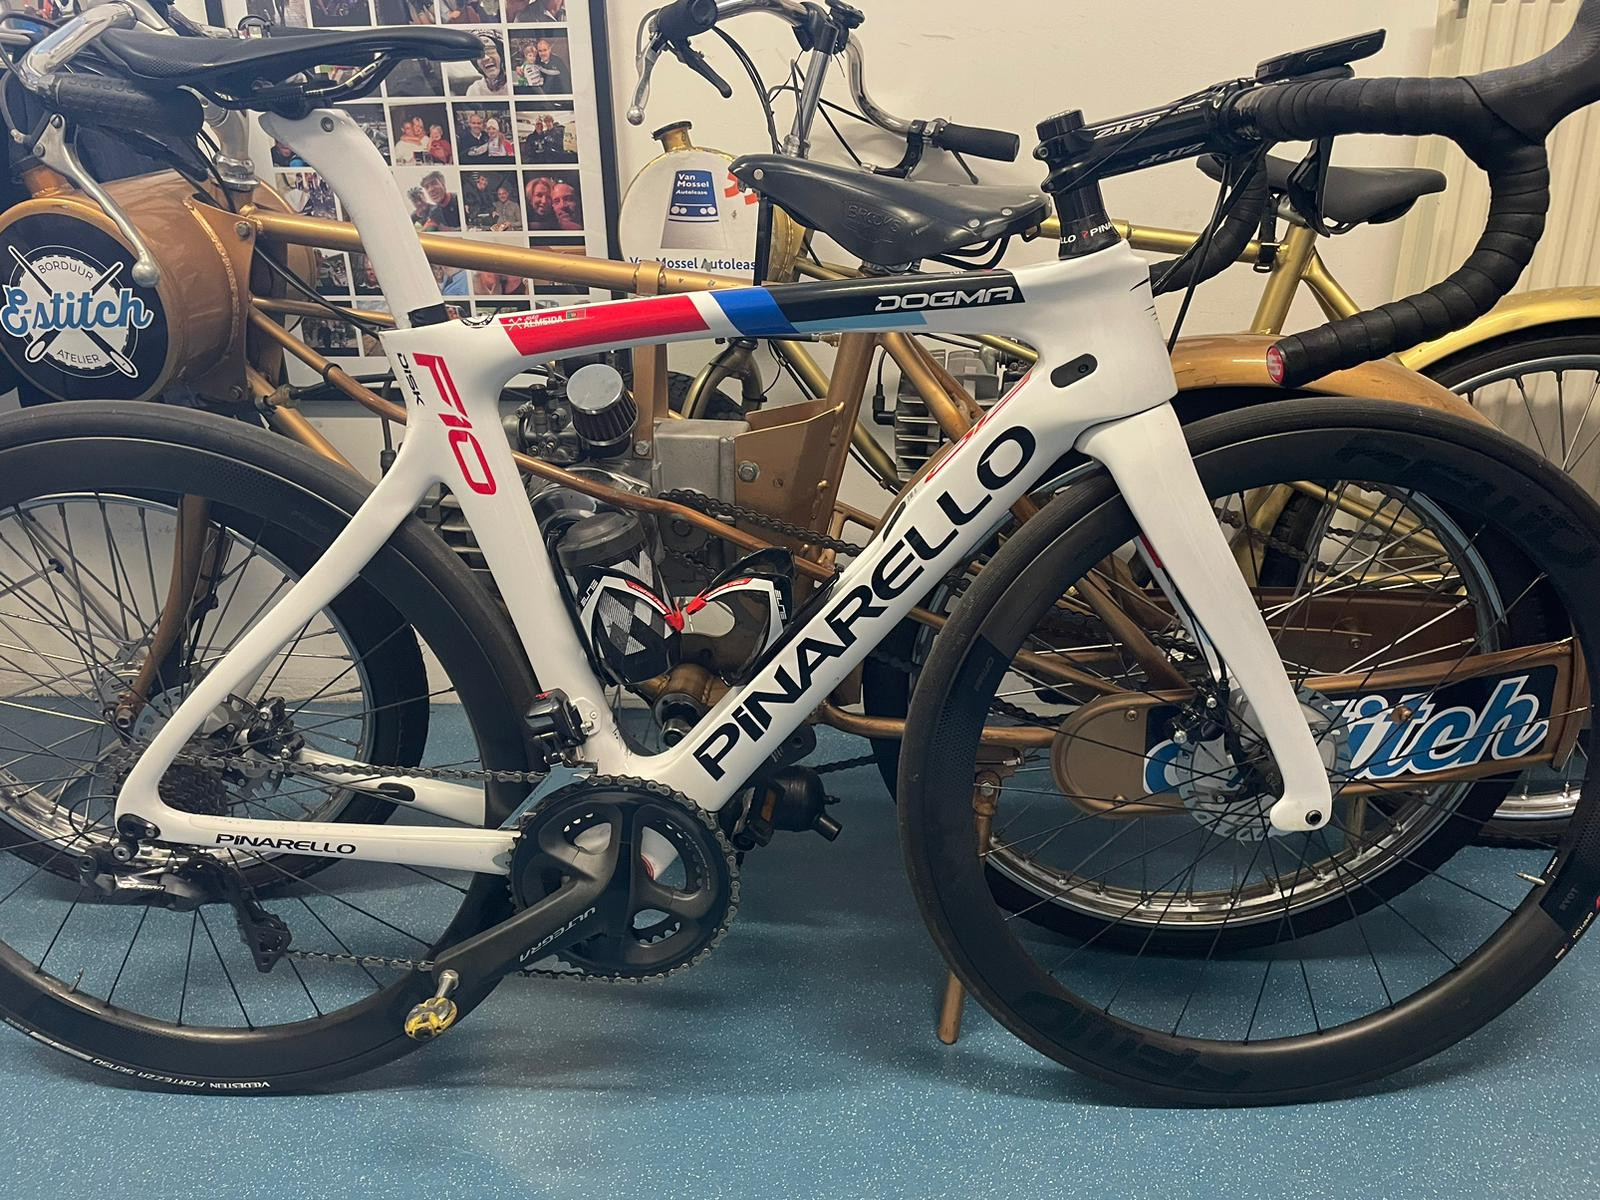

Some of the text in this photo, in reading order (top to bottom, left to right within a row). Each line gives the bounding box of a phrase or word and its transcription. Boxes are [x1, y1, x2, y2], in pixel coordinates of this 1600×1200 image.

[1093, 115, 1161, 140] ZIPP
[1138, 142, 1206, 166] ZIPP
[676, 180, 710, 188] Mossel
[38, 260, 94, 281] BORDUUR
[700, 257, 756, 270] Autoleas
[1, 285, 154, 337] E-stitch
[874, 286, 1014, 312] DOGMA
[523, 315, 563, 329] ALMEIDA
[57, 349, 101, 364] ATELIER
[396, 352, 426, 407] DISK
[411, 351, 498, 496] F10
[691, 424, 1037, 782] PINARELLO
[1341, 672, 1550, 782] itch
[215, 833, 357, 855] PINARELLO
[519, 906, 597, 962] ULTEGRA
[137, 1071, 205, 1088] FORTEZZA
